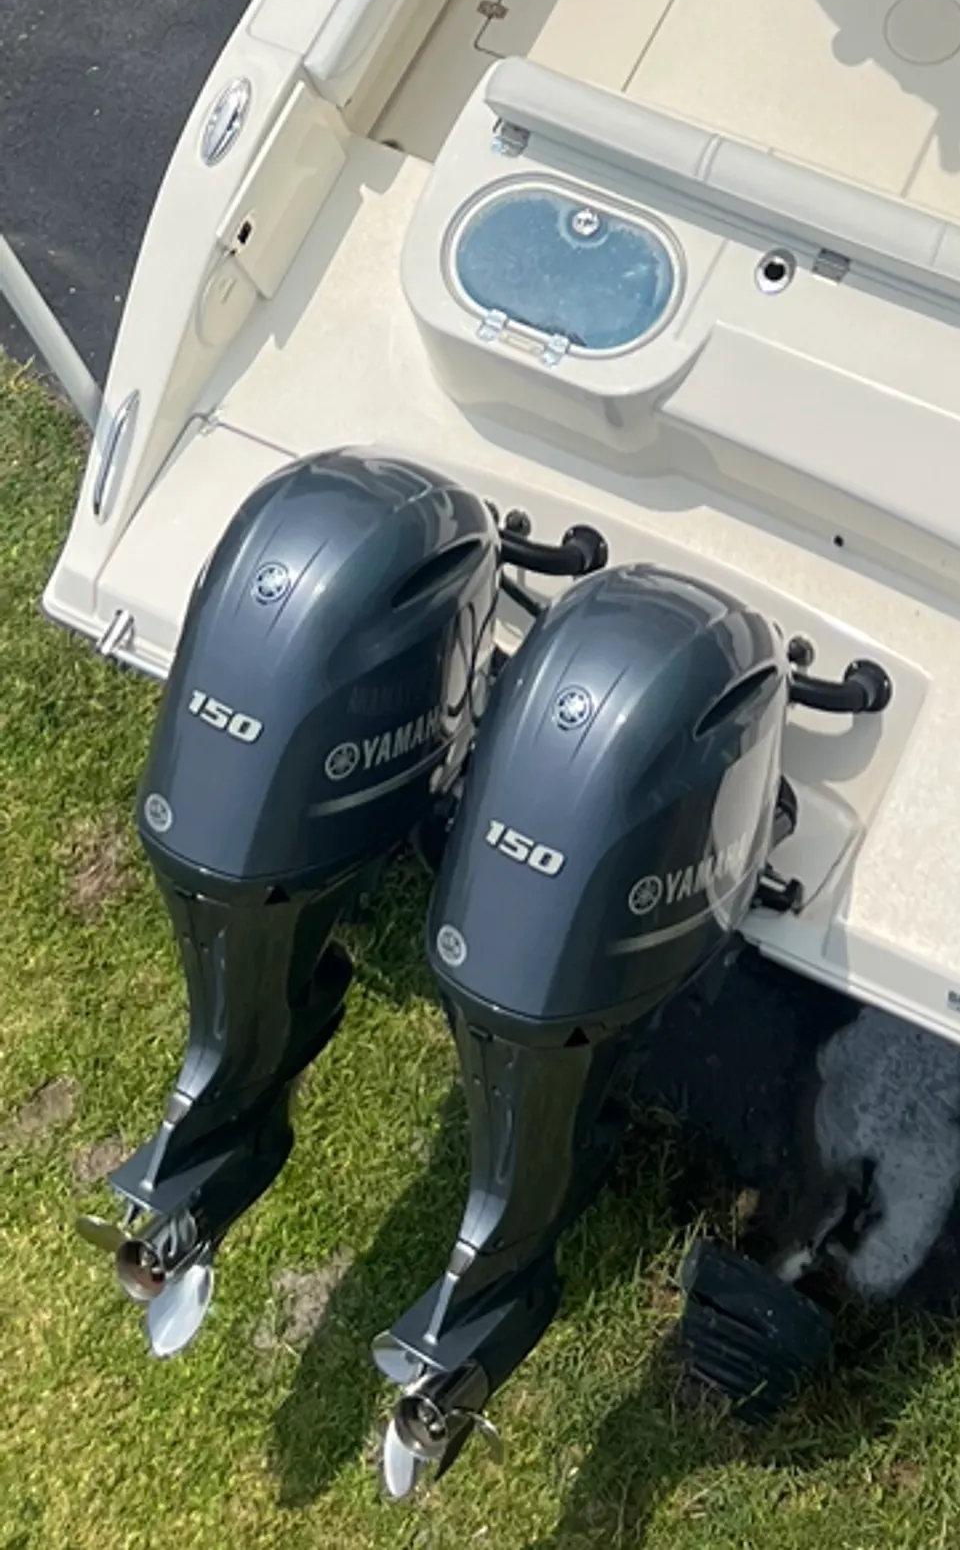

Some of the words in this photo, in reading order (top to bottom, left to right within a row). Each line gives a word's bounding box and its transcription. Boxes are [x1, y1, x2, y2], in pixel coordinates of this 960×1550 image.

[187, 689, 265, 743] 150
[361, 705, 443, 771] YAMAH
[485, 819, 566, 876] 150
